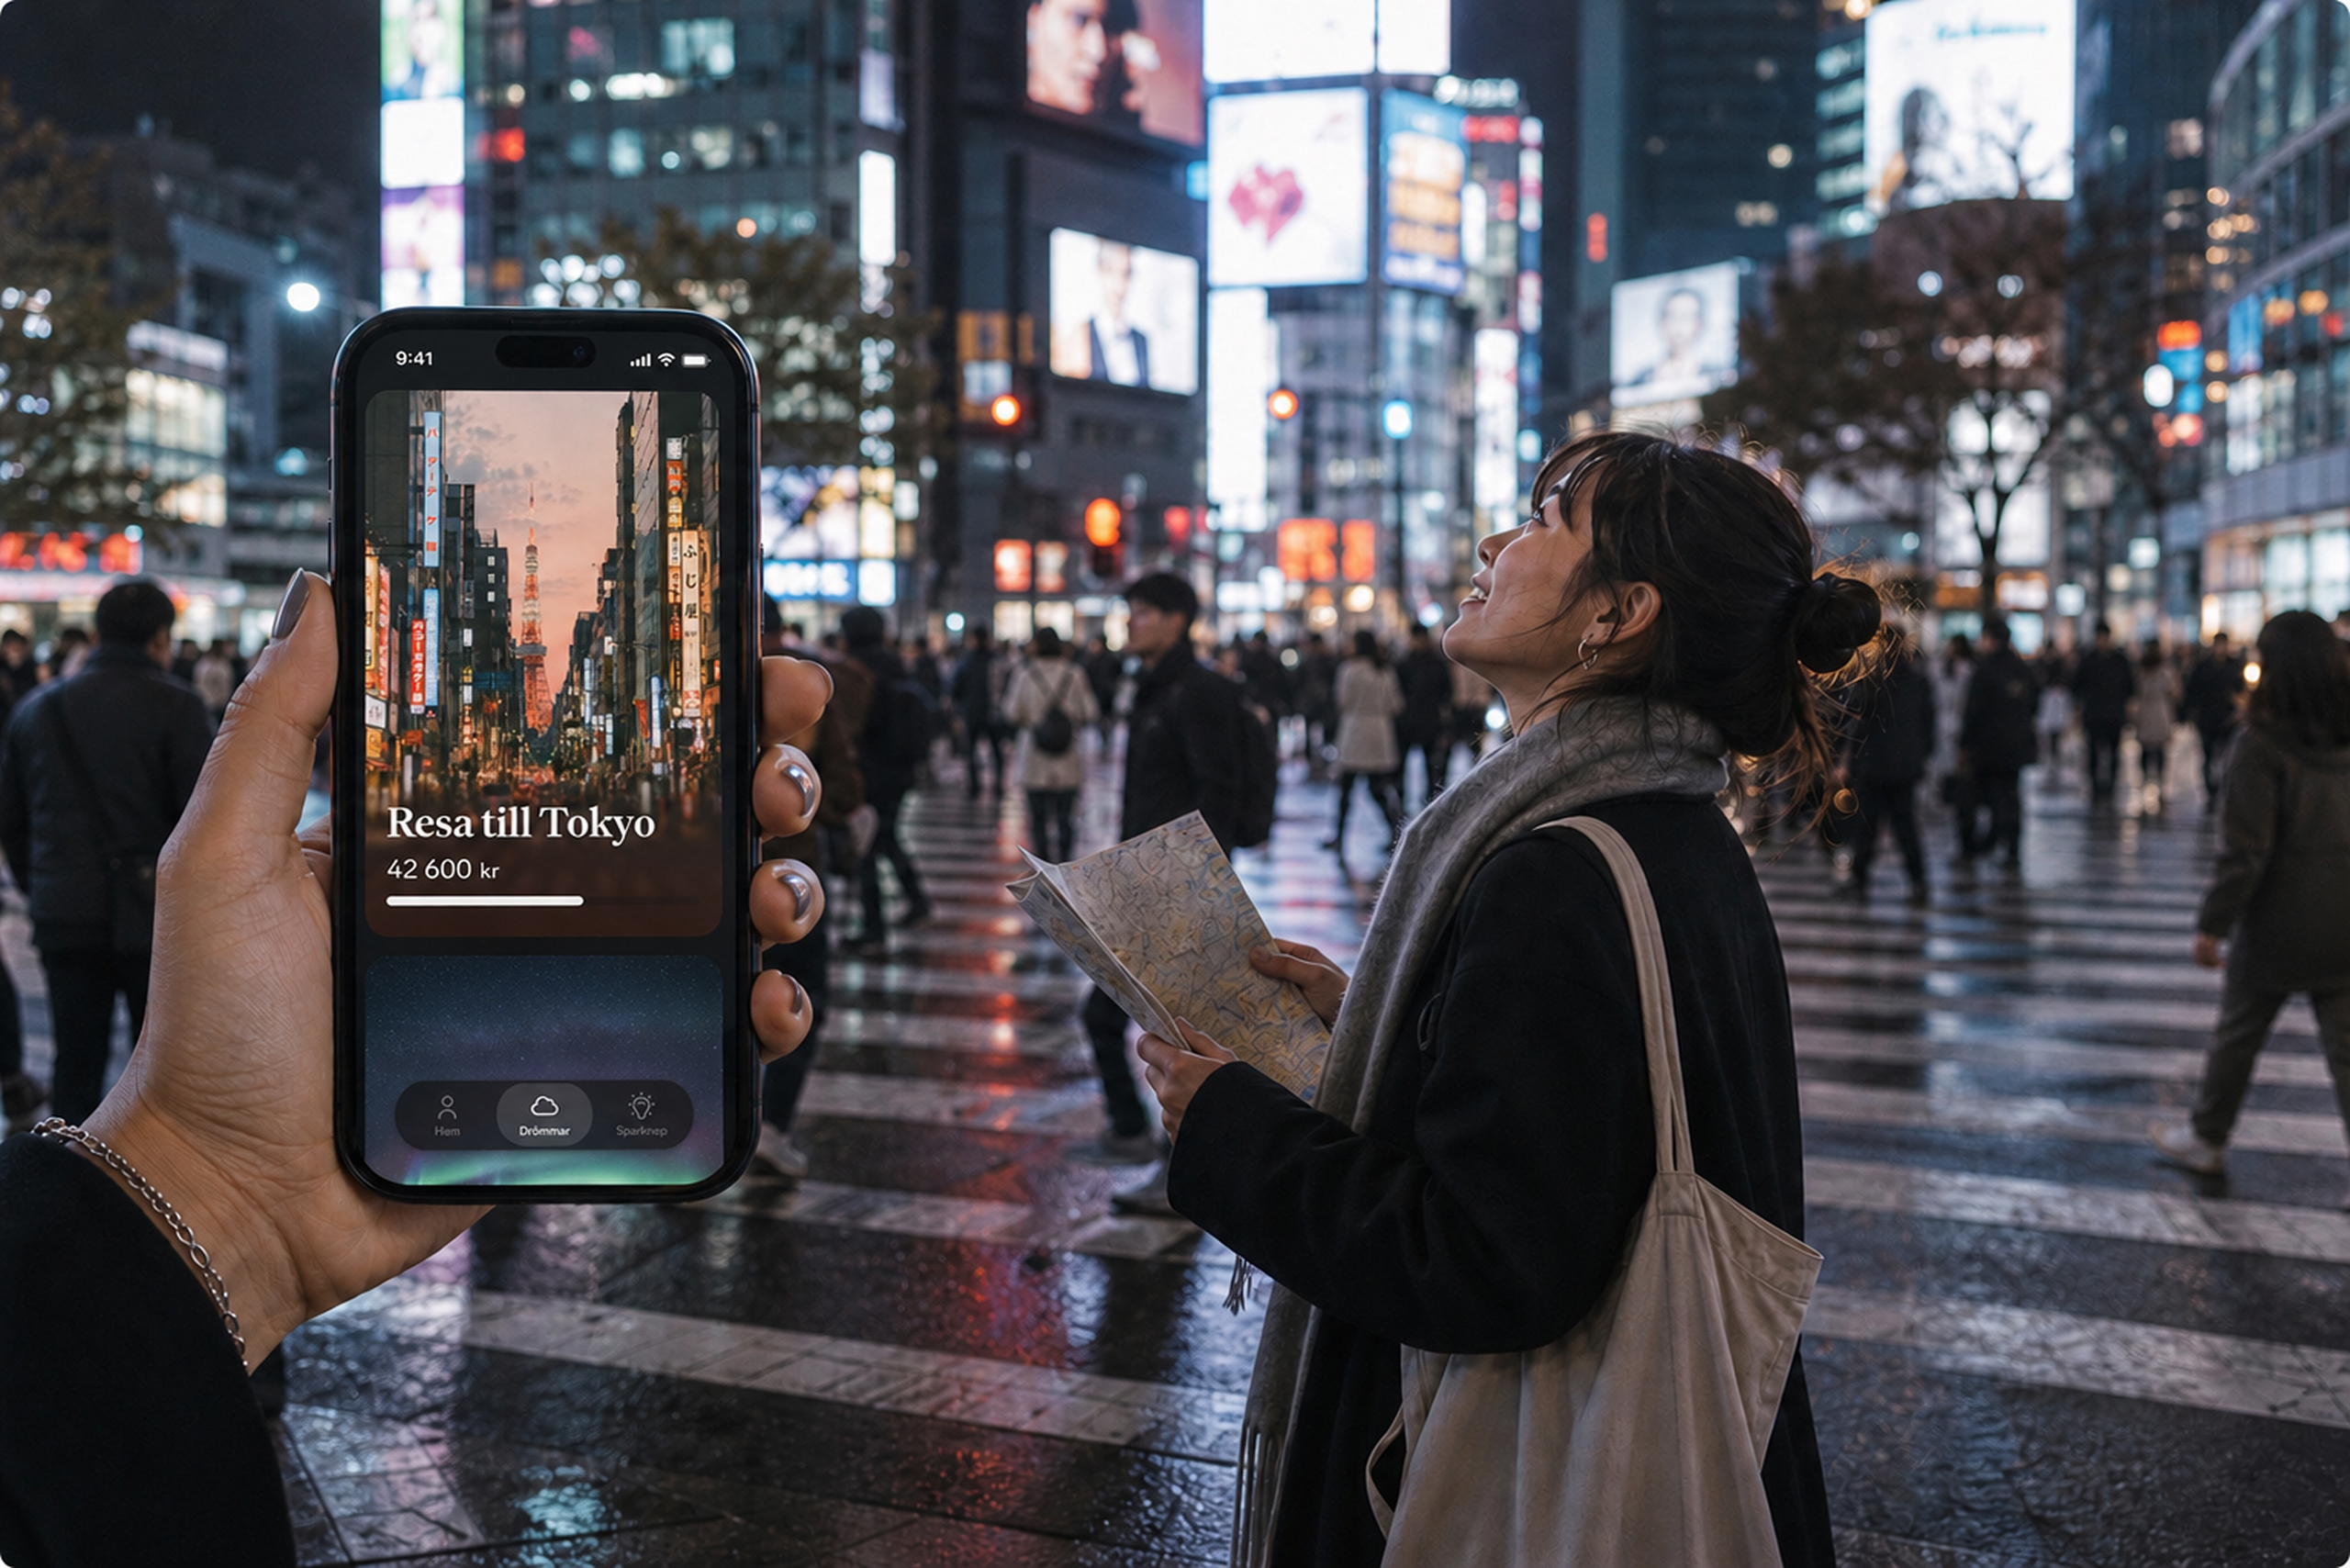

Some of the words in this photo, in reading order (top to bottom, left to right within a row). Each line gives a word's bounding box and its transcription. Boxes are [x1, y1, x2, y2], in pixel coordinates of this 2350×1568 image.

[395, 350, 432, 366] 9:41
[386, 806, 474, 838] Resa
[480, 805, 532, 838] till
[539, 805, 655, 846] Tokyo
[386, 858, 418, 879] 42
[424, 858, 472, 879] 600
[480, 861, 500, 879] kr
[434, 1126, 461, 1137] Hem
[519, 1124, 571, 1137] Drömmar
[616, 1125, 668, 1137] Sparknep
